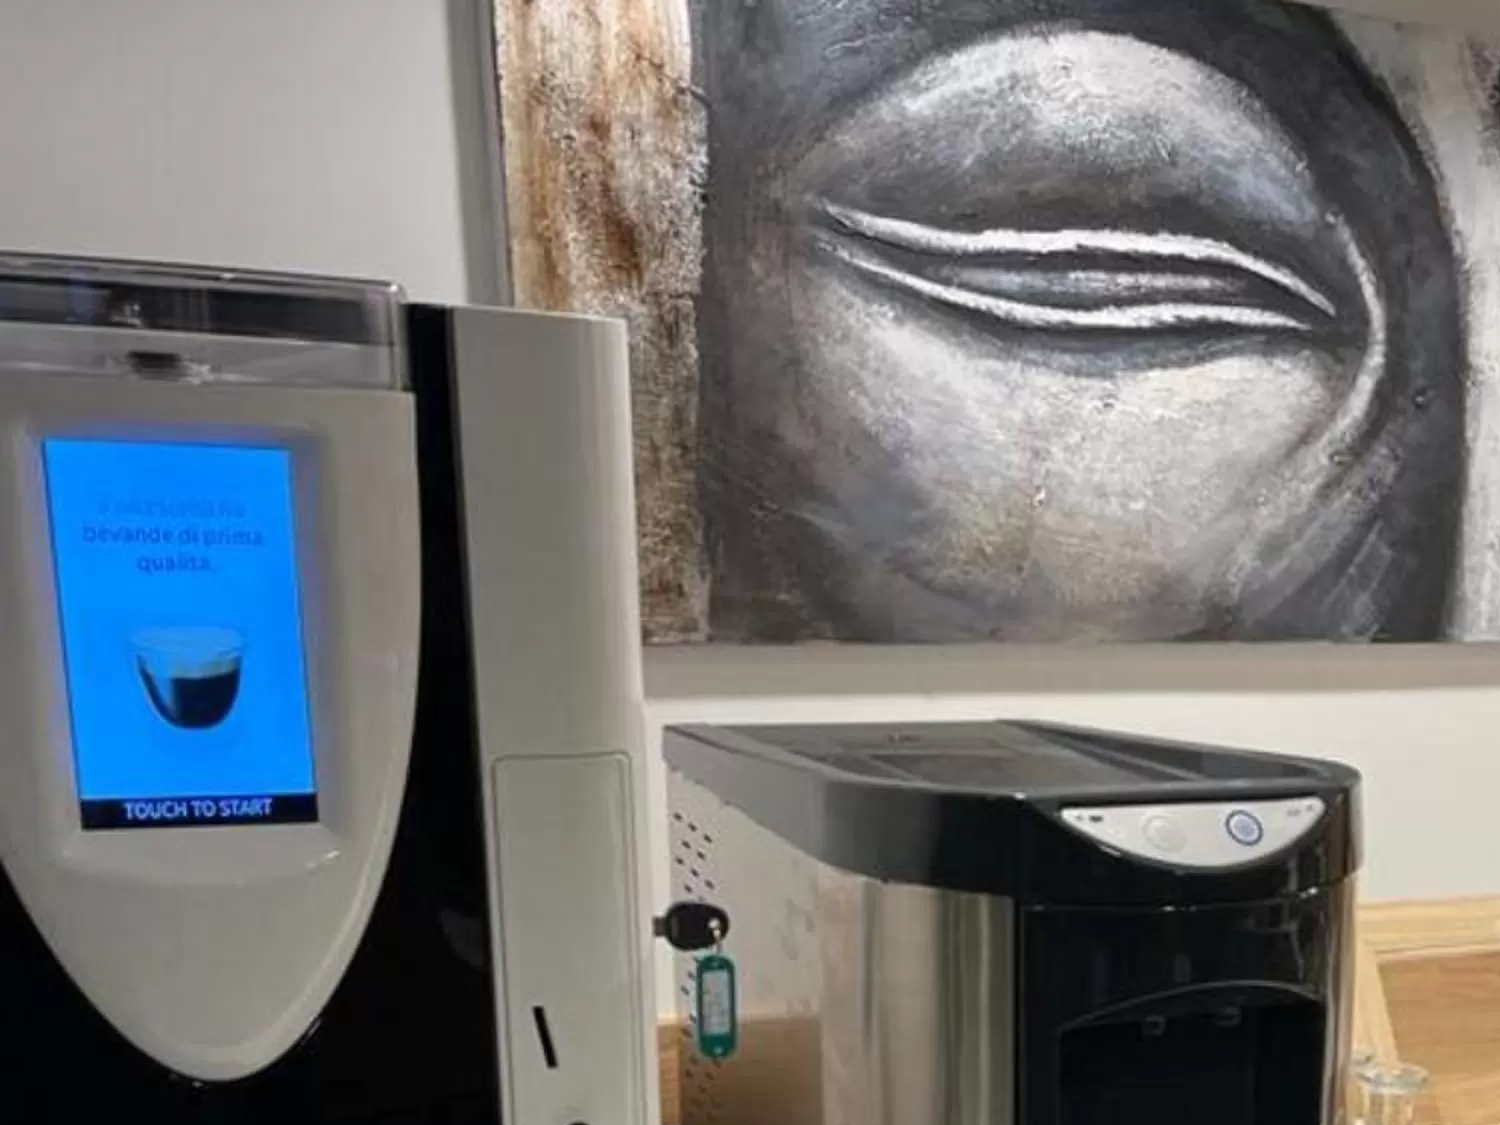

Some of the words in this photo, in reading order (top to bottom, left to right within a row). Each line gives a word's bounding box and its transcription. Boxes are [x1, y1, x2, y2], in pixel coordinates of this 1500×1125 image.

[124, 800, 187, 820] TOUCH
[190, 799, 217, 818] TO
[218, 797, 273, 818] START
